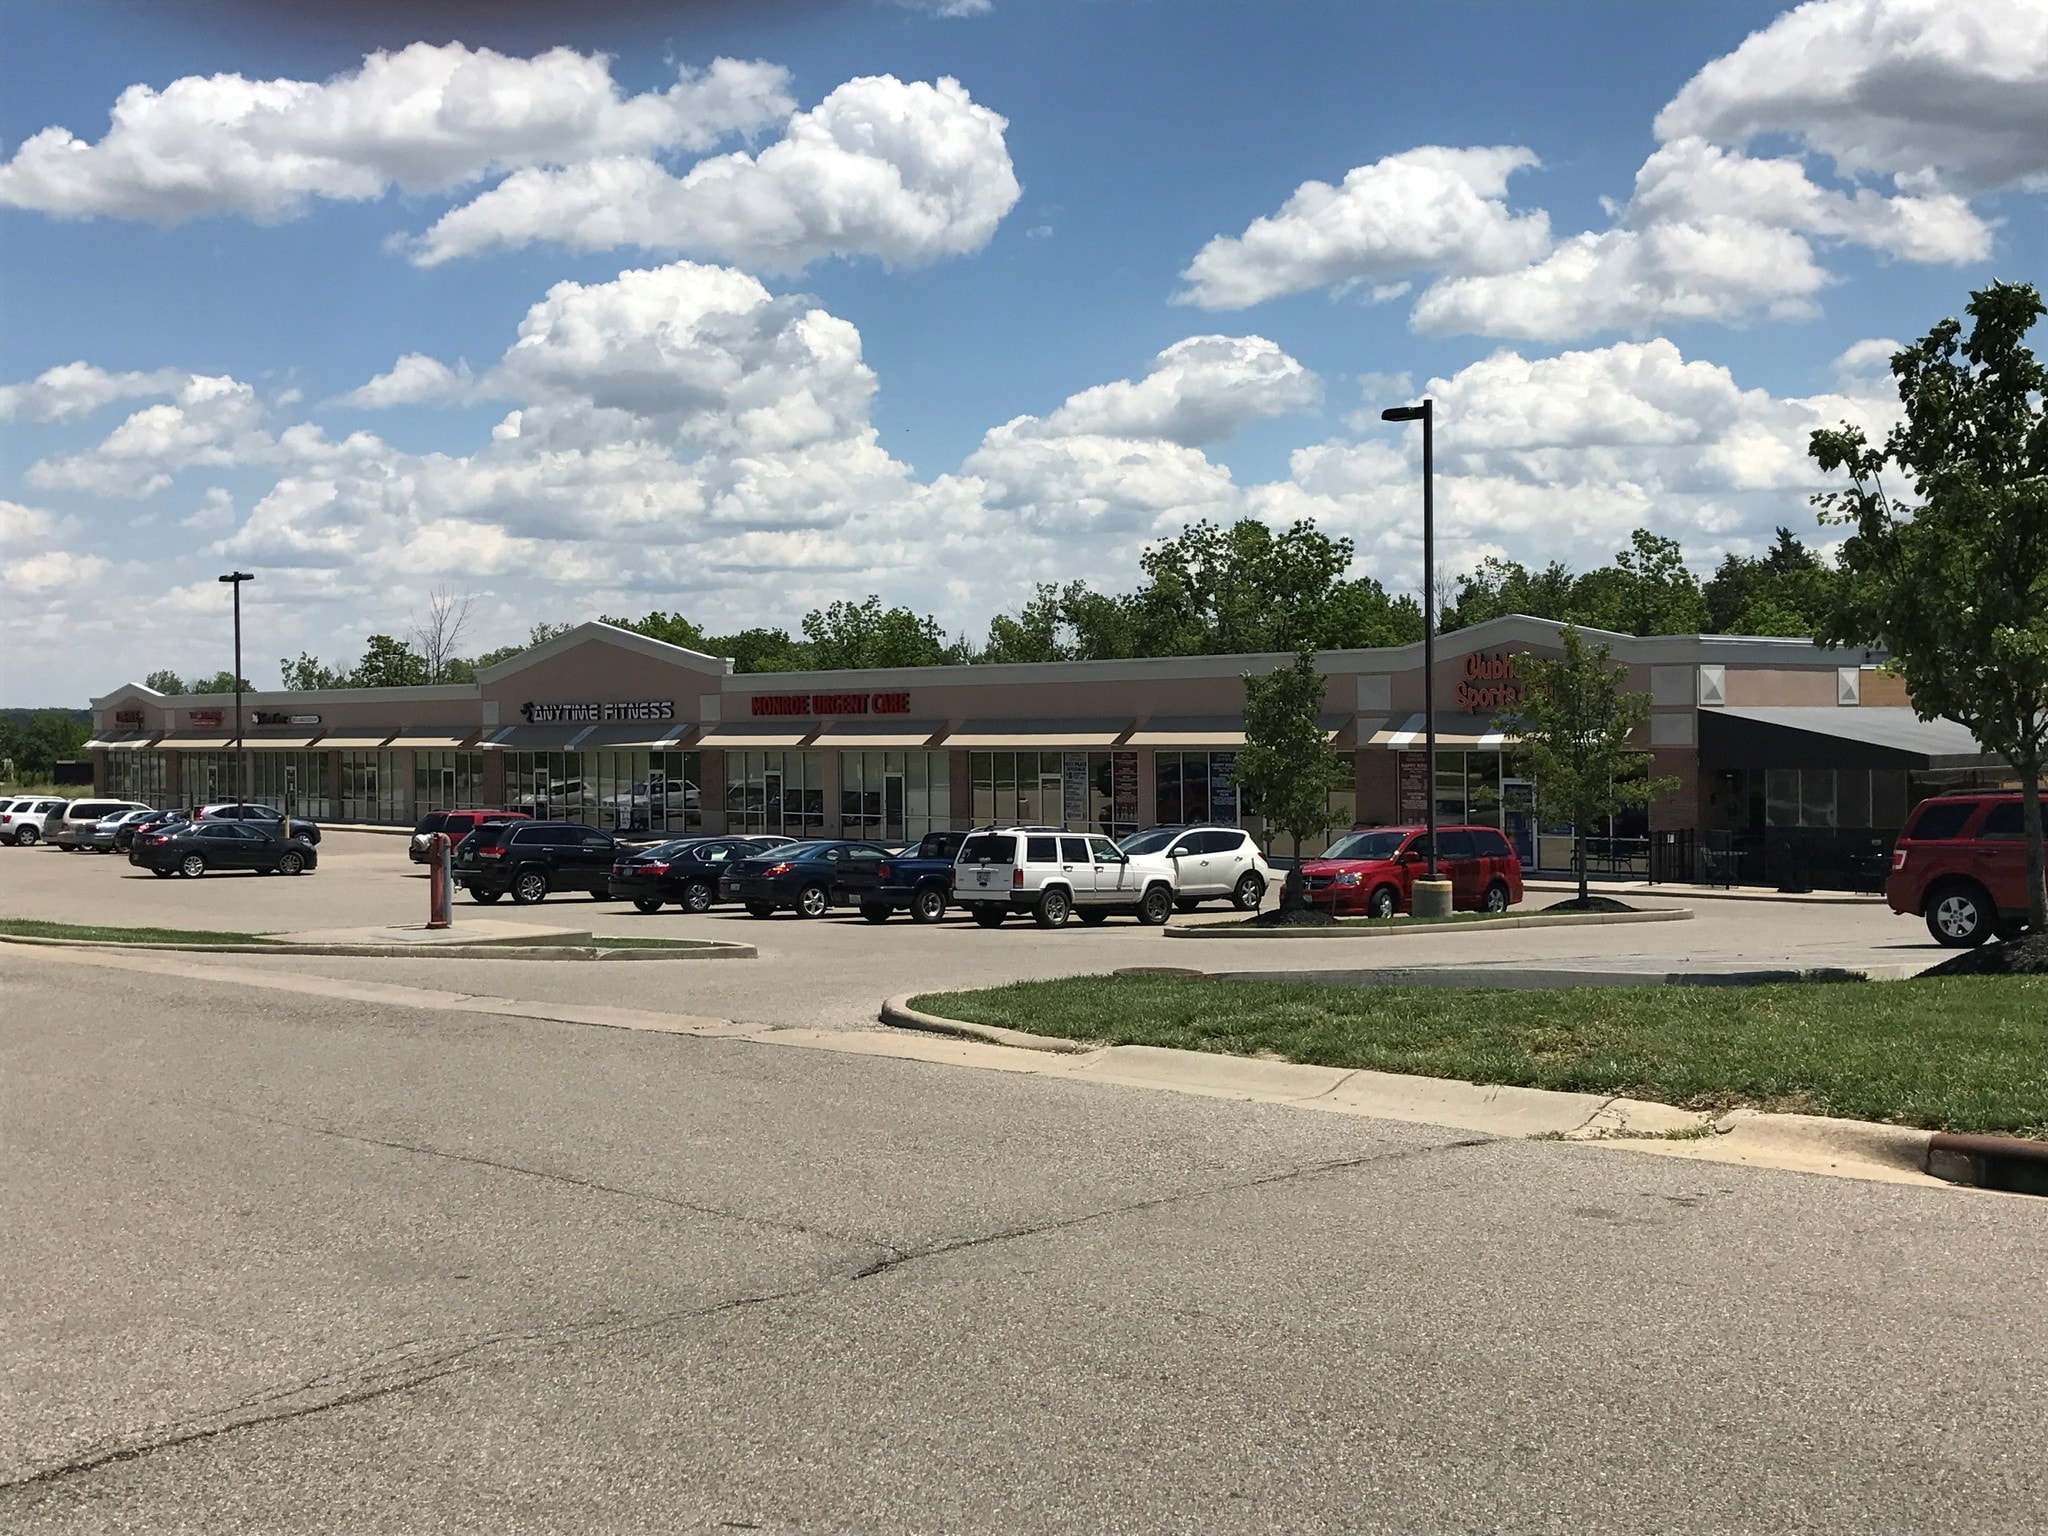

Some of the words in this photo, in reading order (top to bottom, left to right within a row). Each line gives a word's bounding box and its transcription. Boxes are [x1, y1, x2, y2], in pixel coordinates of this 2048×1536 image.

[1463, 652, 1550, 680] Clubh
[751, 695, 810, 716] MONROE
[812, 694, 869, 714] URGENT
[871, 693, 910, 714] CARE
[1456, 680, 1518, 714] Sports
[533, 703, 600, 721] ANYTIME
[604, 701, 674, 720] FITNESS
